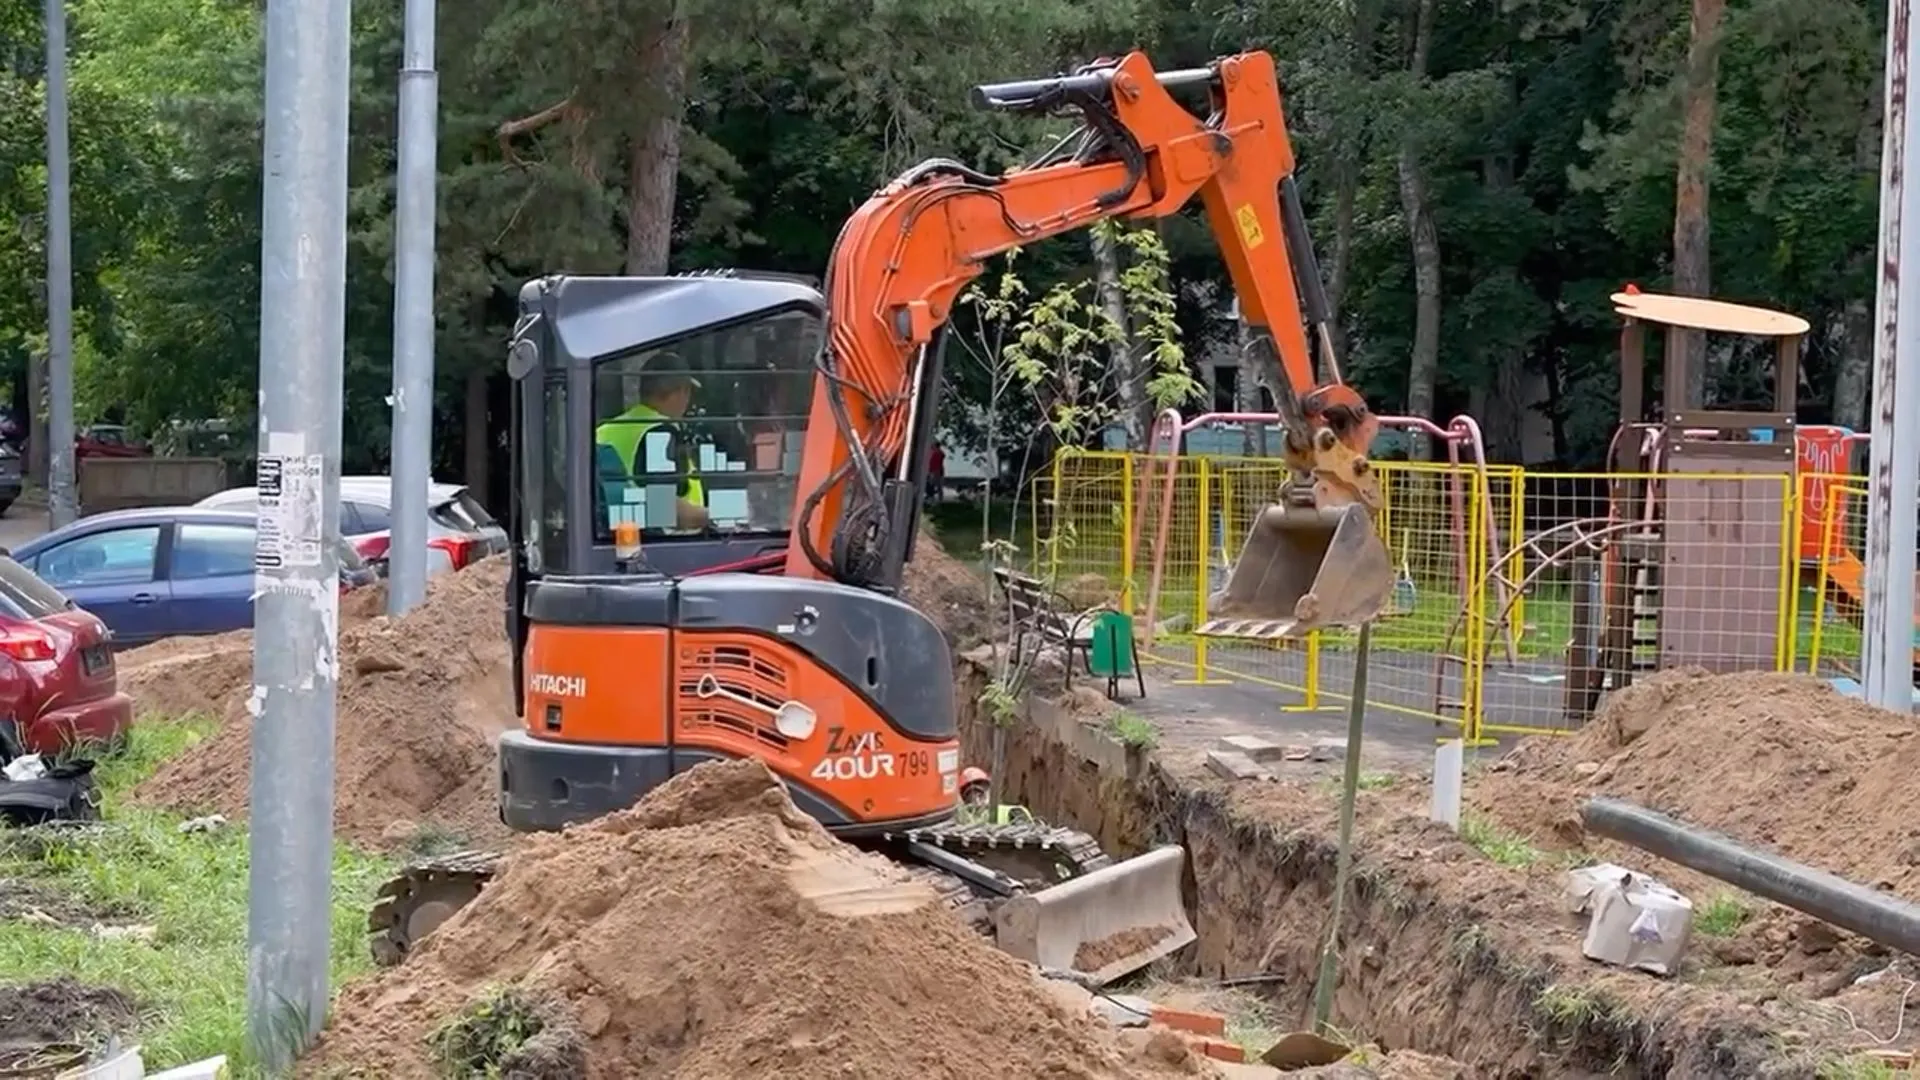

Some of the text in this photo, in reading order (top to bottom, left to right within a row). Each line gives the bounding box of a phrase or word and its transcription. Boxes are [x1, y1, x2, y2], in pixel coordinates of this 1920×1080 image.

[530, 674, 586, 697] HITACHI
[811, 754, 895, 781] 40UR
[900, 751, 929, 778] 799
